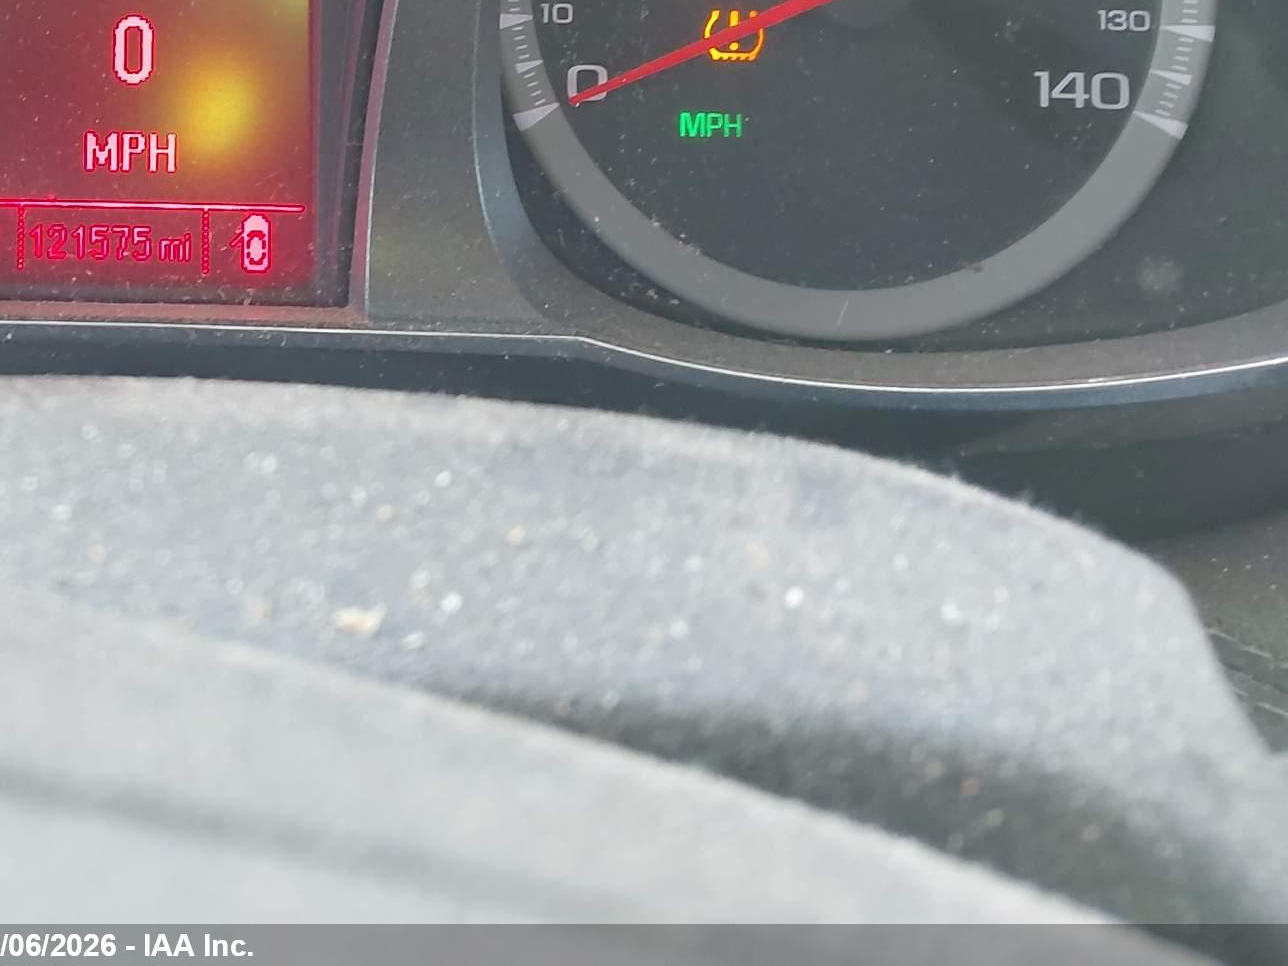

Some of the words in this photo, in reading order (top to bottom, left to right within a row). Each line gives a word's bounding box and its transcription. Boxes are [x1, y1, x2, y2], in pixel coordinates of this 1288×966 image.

[541, 3, 573, 24] 10
[1097, 9, 1150, 32] 130
[112, 13, 155, 85] 0
[566, 64, 609, 102] 0
[1034, 71, 1130, 110] 140
[679, 112, 742, 138] MPH
[83, 131, 177, 173] MPH
[29, 223, 153, 260] 121575
[158, 233, 192, 262] mi
